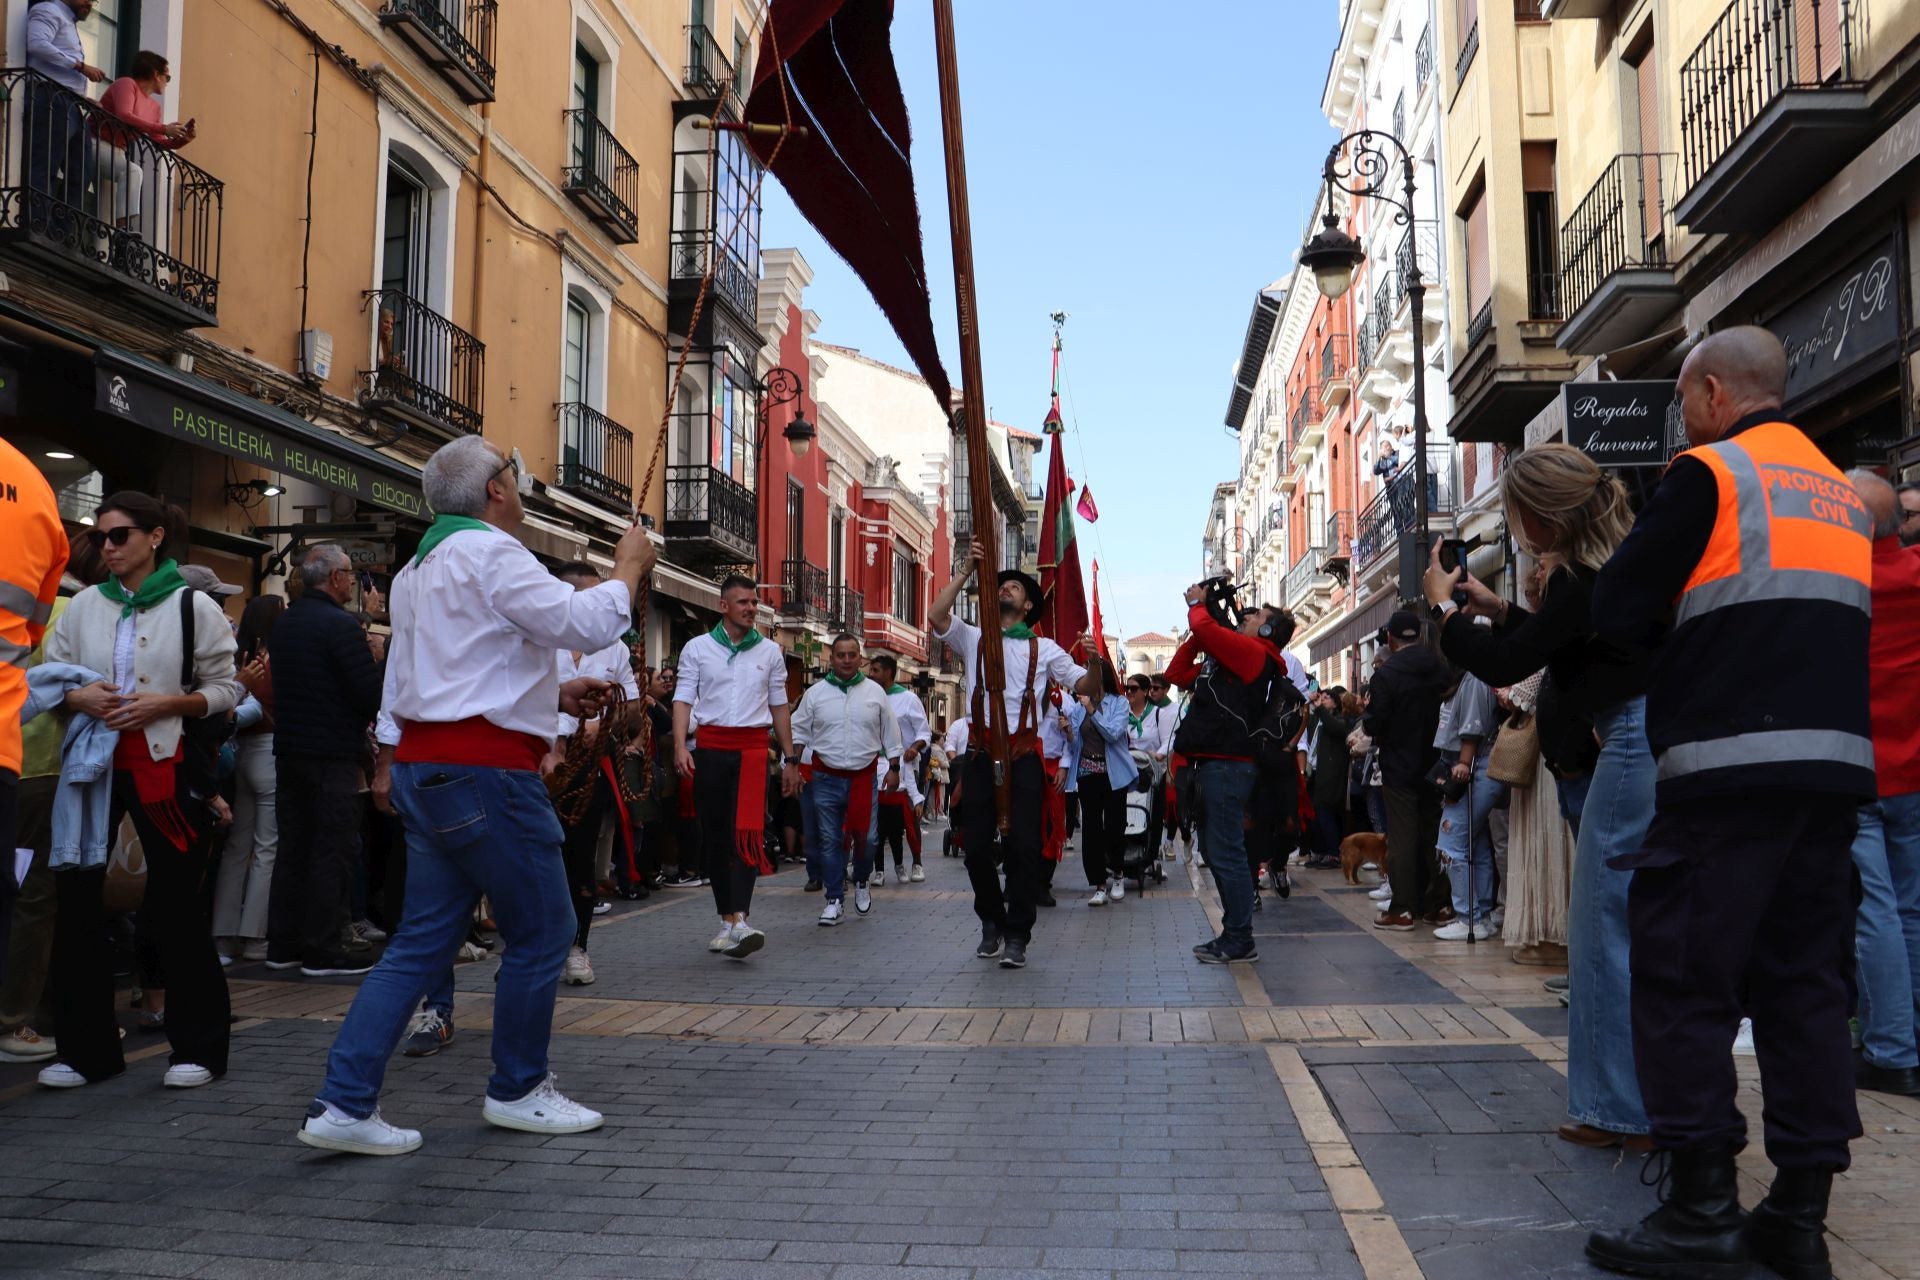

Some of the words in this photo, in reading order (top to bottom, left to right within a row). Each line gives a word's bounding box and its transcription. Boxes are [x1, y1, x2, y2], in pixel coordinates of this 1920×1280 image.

[1573, 396, 1648, 425] Regalos
[1577, 431, 1658, 452] Souvenir
[173, 407, 274, 462] PASTELERÍA
[285, 448, 359, 492] HELADERÍA
[372, 482, 422, 515] albany
[1809, 497, 1853, 527] CIVIL
